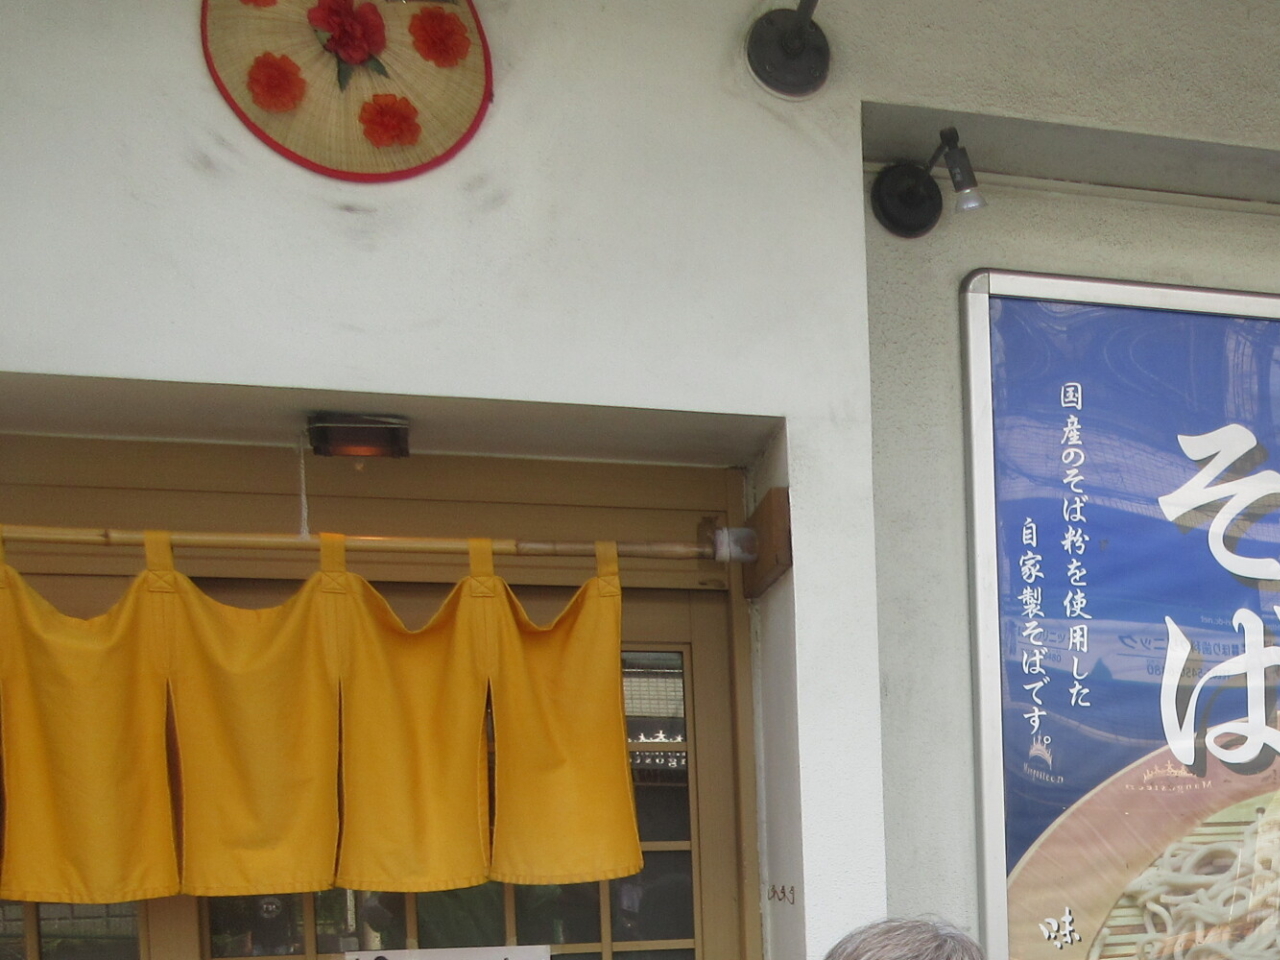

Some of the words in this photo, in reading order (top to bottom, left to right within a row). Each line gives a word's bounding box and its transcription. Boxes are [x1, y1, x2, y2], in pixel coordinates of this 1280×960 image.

[1017, 517, 1053, 746] 自家製そばです。
[1059, 382, 1092, 707] 国産のそば粉を使用した
